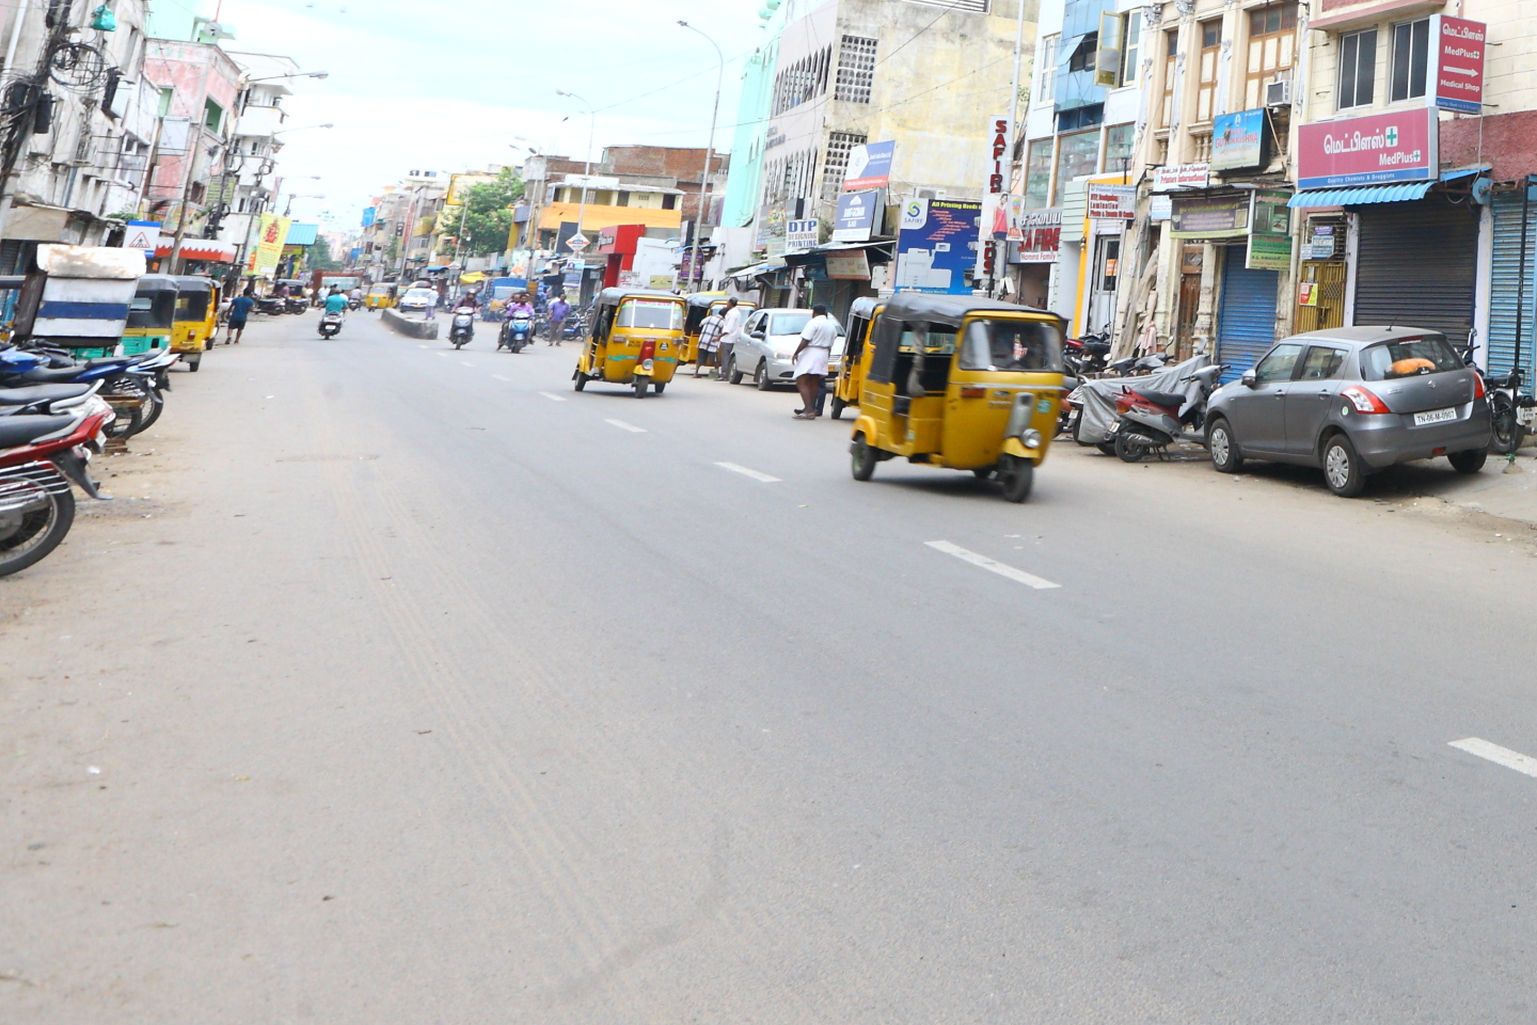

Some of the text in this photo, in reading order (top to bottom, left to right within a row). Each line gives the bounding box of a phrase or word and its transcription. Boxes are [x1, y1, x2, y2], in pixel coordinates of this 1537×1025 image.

[1444, 45, 1474, 58] MedPlus
[1440, 79, 1480, 93] Medical Shop
[1379, 151, 1414, 166] MedPlus
[788, 221, 817, 233] DTP
[788, 240, 817, 248] PRINTING
